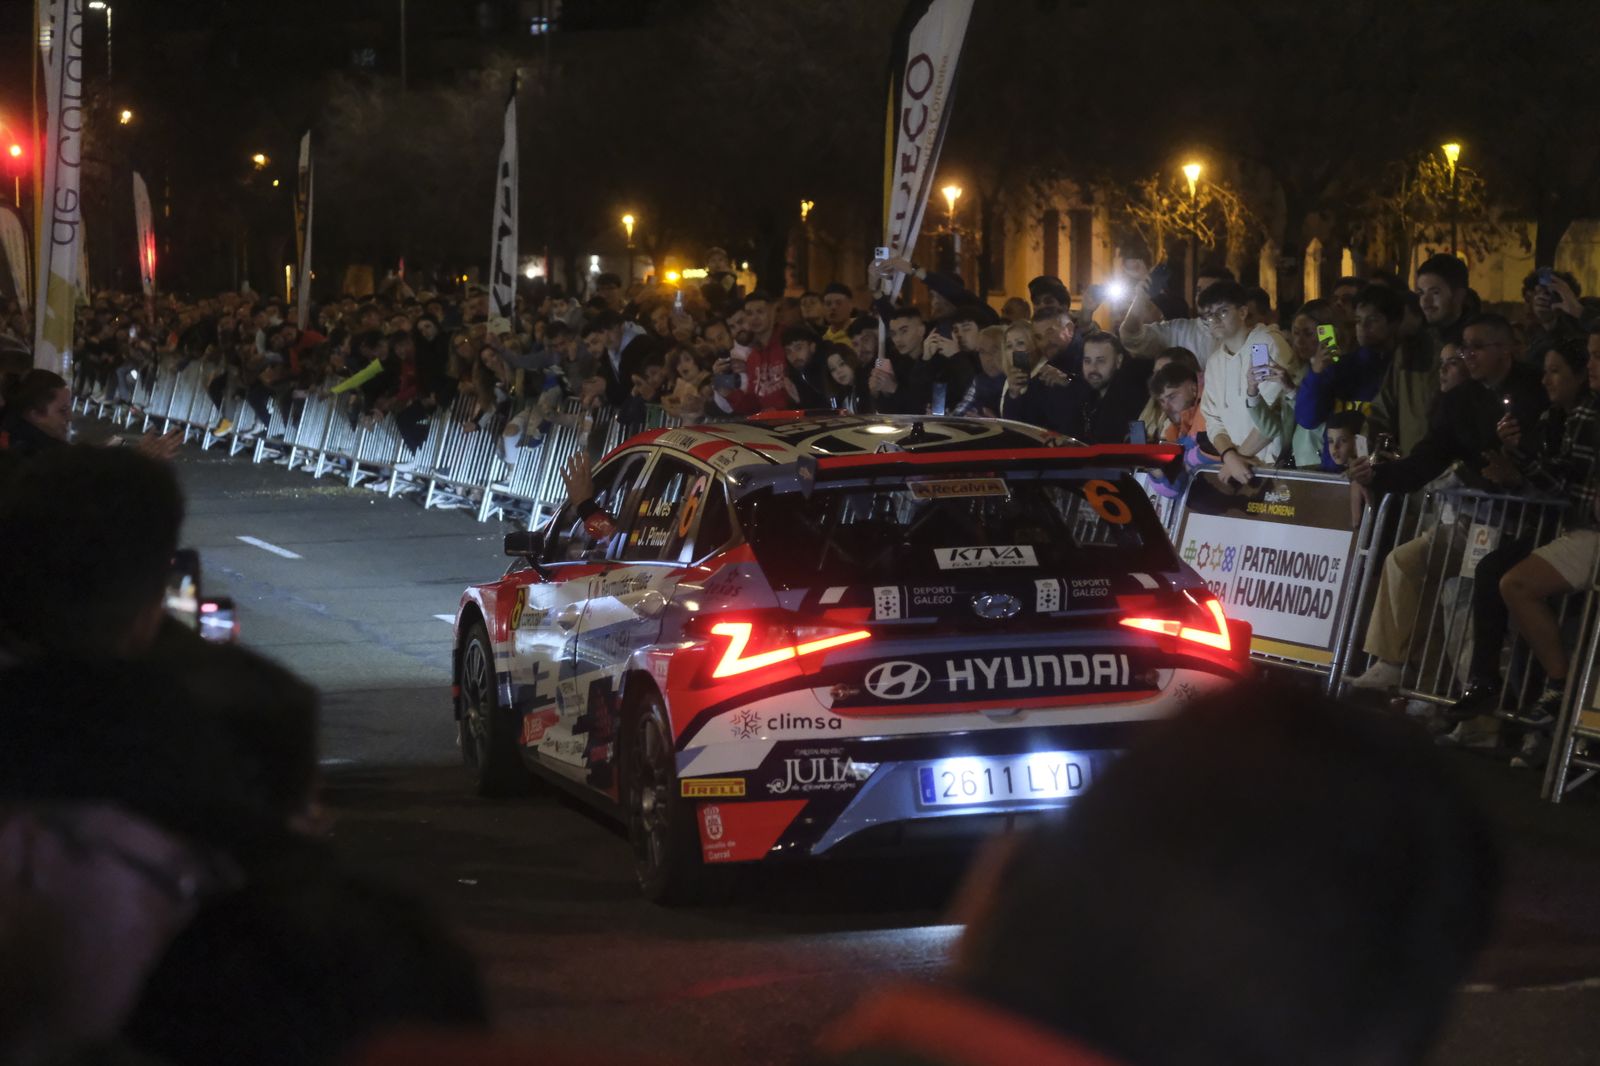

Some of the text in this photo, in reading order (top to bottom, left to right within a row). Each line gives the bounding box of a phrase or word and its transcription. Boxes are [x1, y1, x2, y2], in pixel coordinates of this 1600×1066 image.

[679, 475, 707, 538] 6
[1084, 479, 1132, 525] 6
[1246, 502, 1295, 517] SIERRA MORENA
[950, 546, 1025, 562] KTVA
[1241, 545, 1341, 583] PATRIMONIO DE
[1072, 578, 1111, 588] DEPORTE
[1328, 572, 1337, 584] LA
[913, 586, 956, 595] DEPORTE
[1072, 588, 1109, 598] GALEGO
[1233, 577, 1334, 620] HUMANIDAD
[914, 596, 953, 605] GALEGO
[946, 654, 1130, 692] HYUNDAI
[767, 713, 842, 730] climsa
[768, 757, 867, 794] JULIA
[940, 762, 1083, 798] 2611 LYD
[684, 779, 744, 795] PIRELLI
